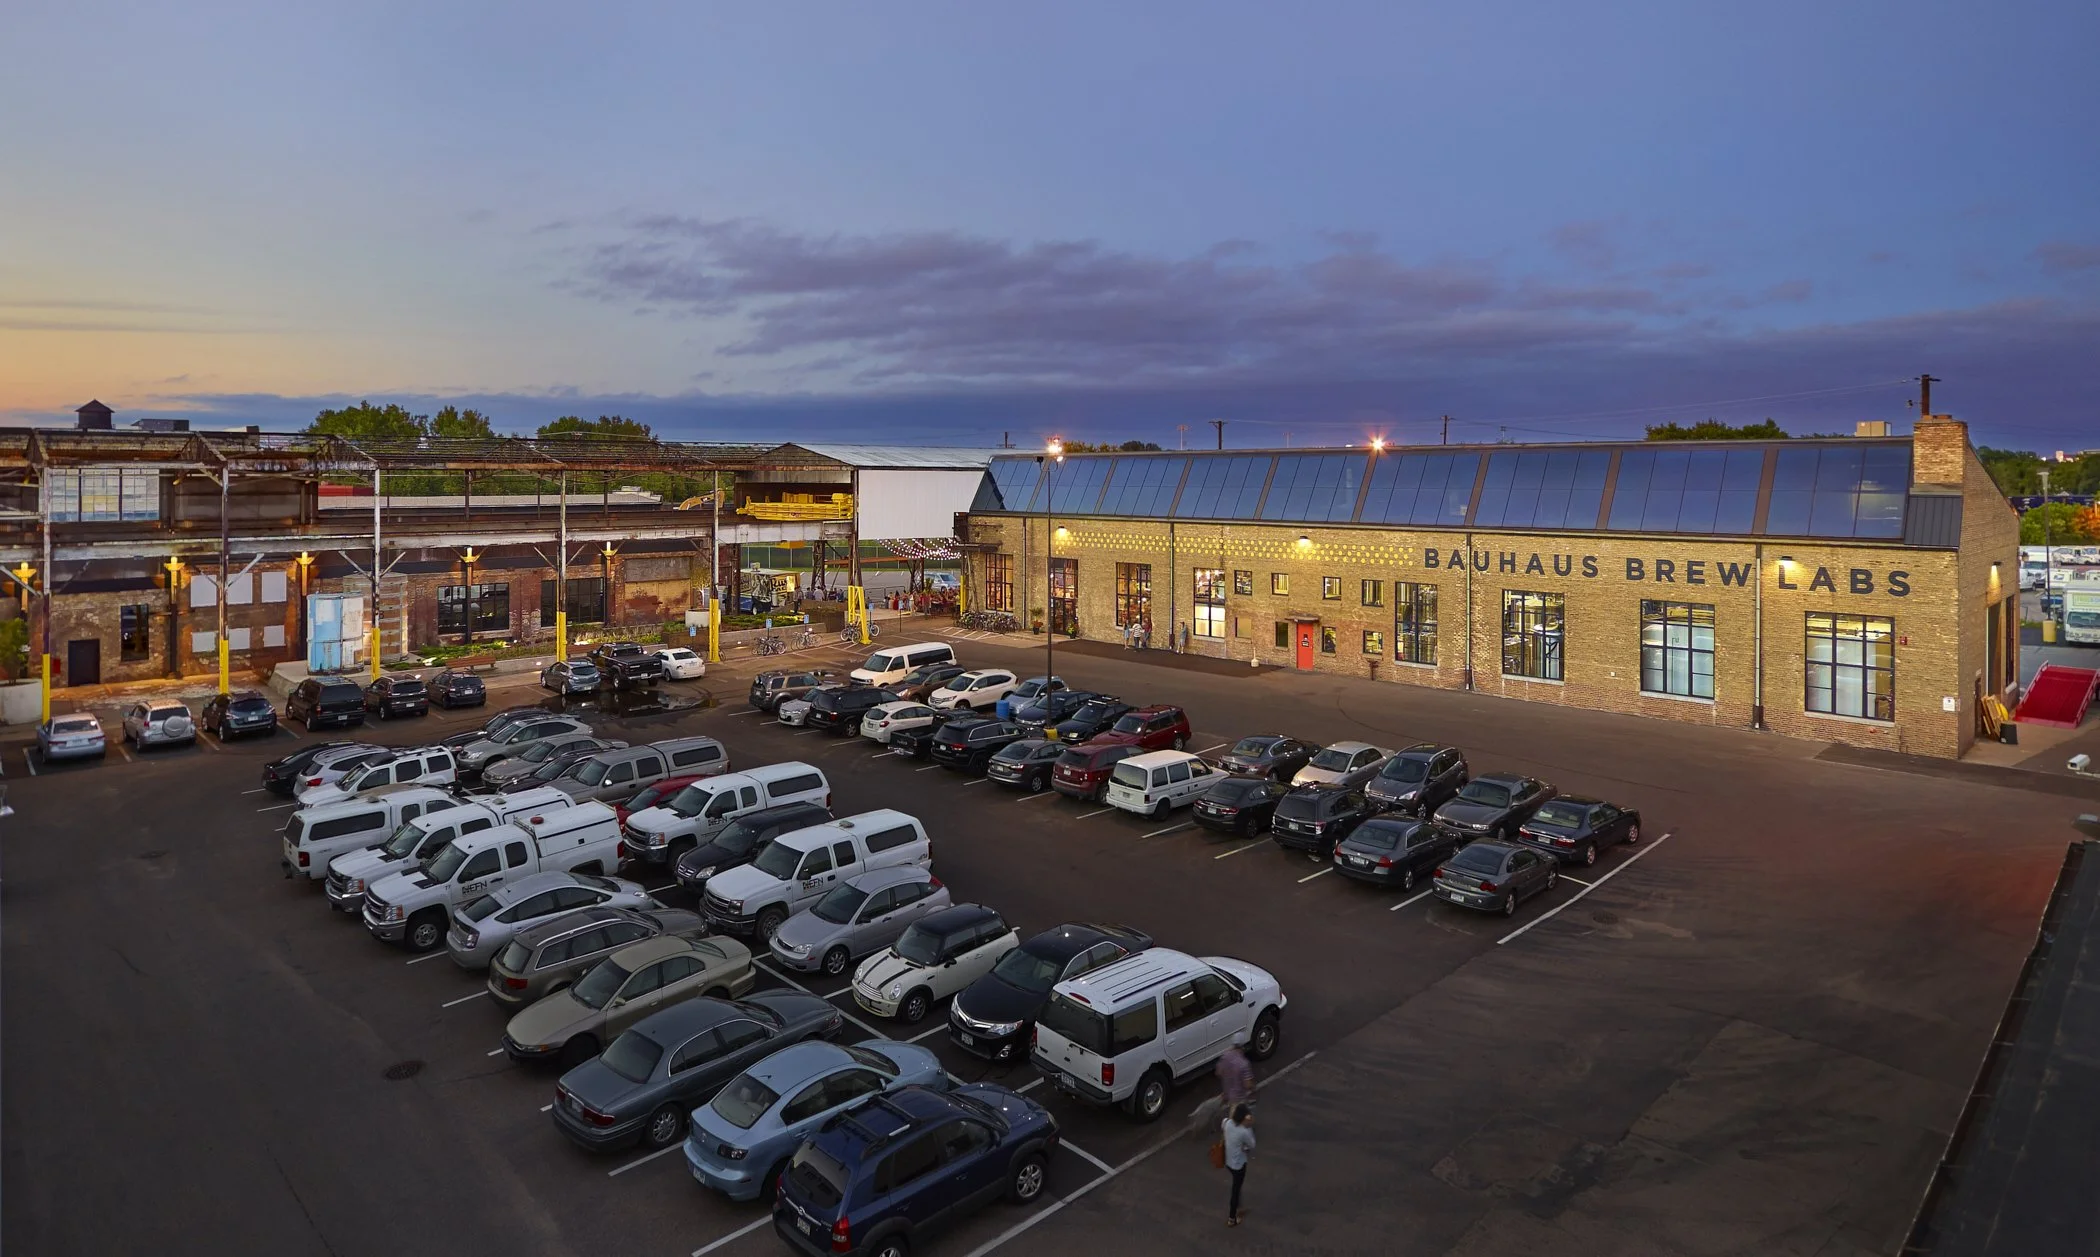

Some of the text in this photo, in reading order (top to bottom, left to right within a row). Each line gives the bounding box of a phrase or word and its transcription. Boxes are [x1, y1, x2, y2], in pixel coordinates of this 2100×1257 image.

[1424, 548, 1911, 597] BAUHAUS BREW LABS
